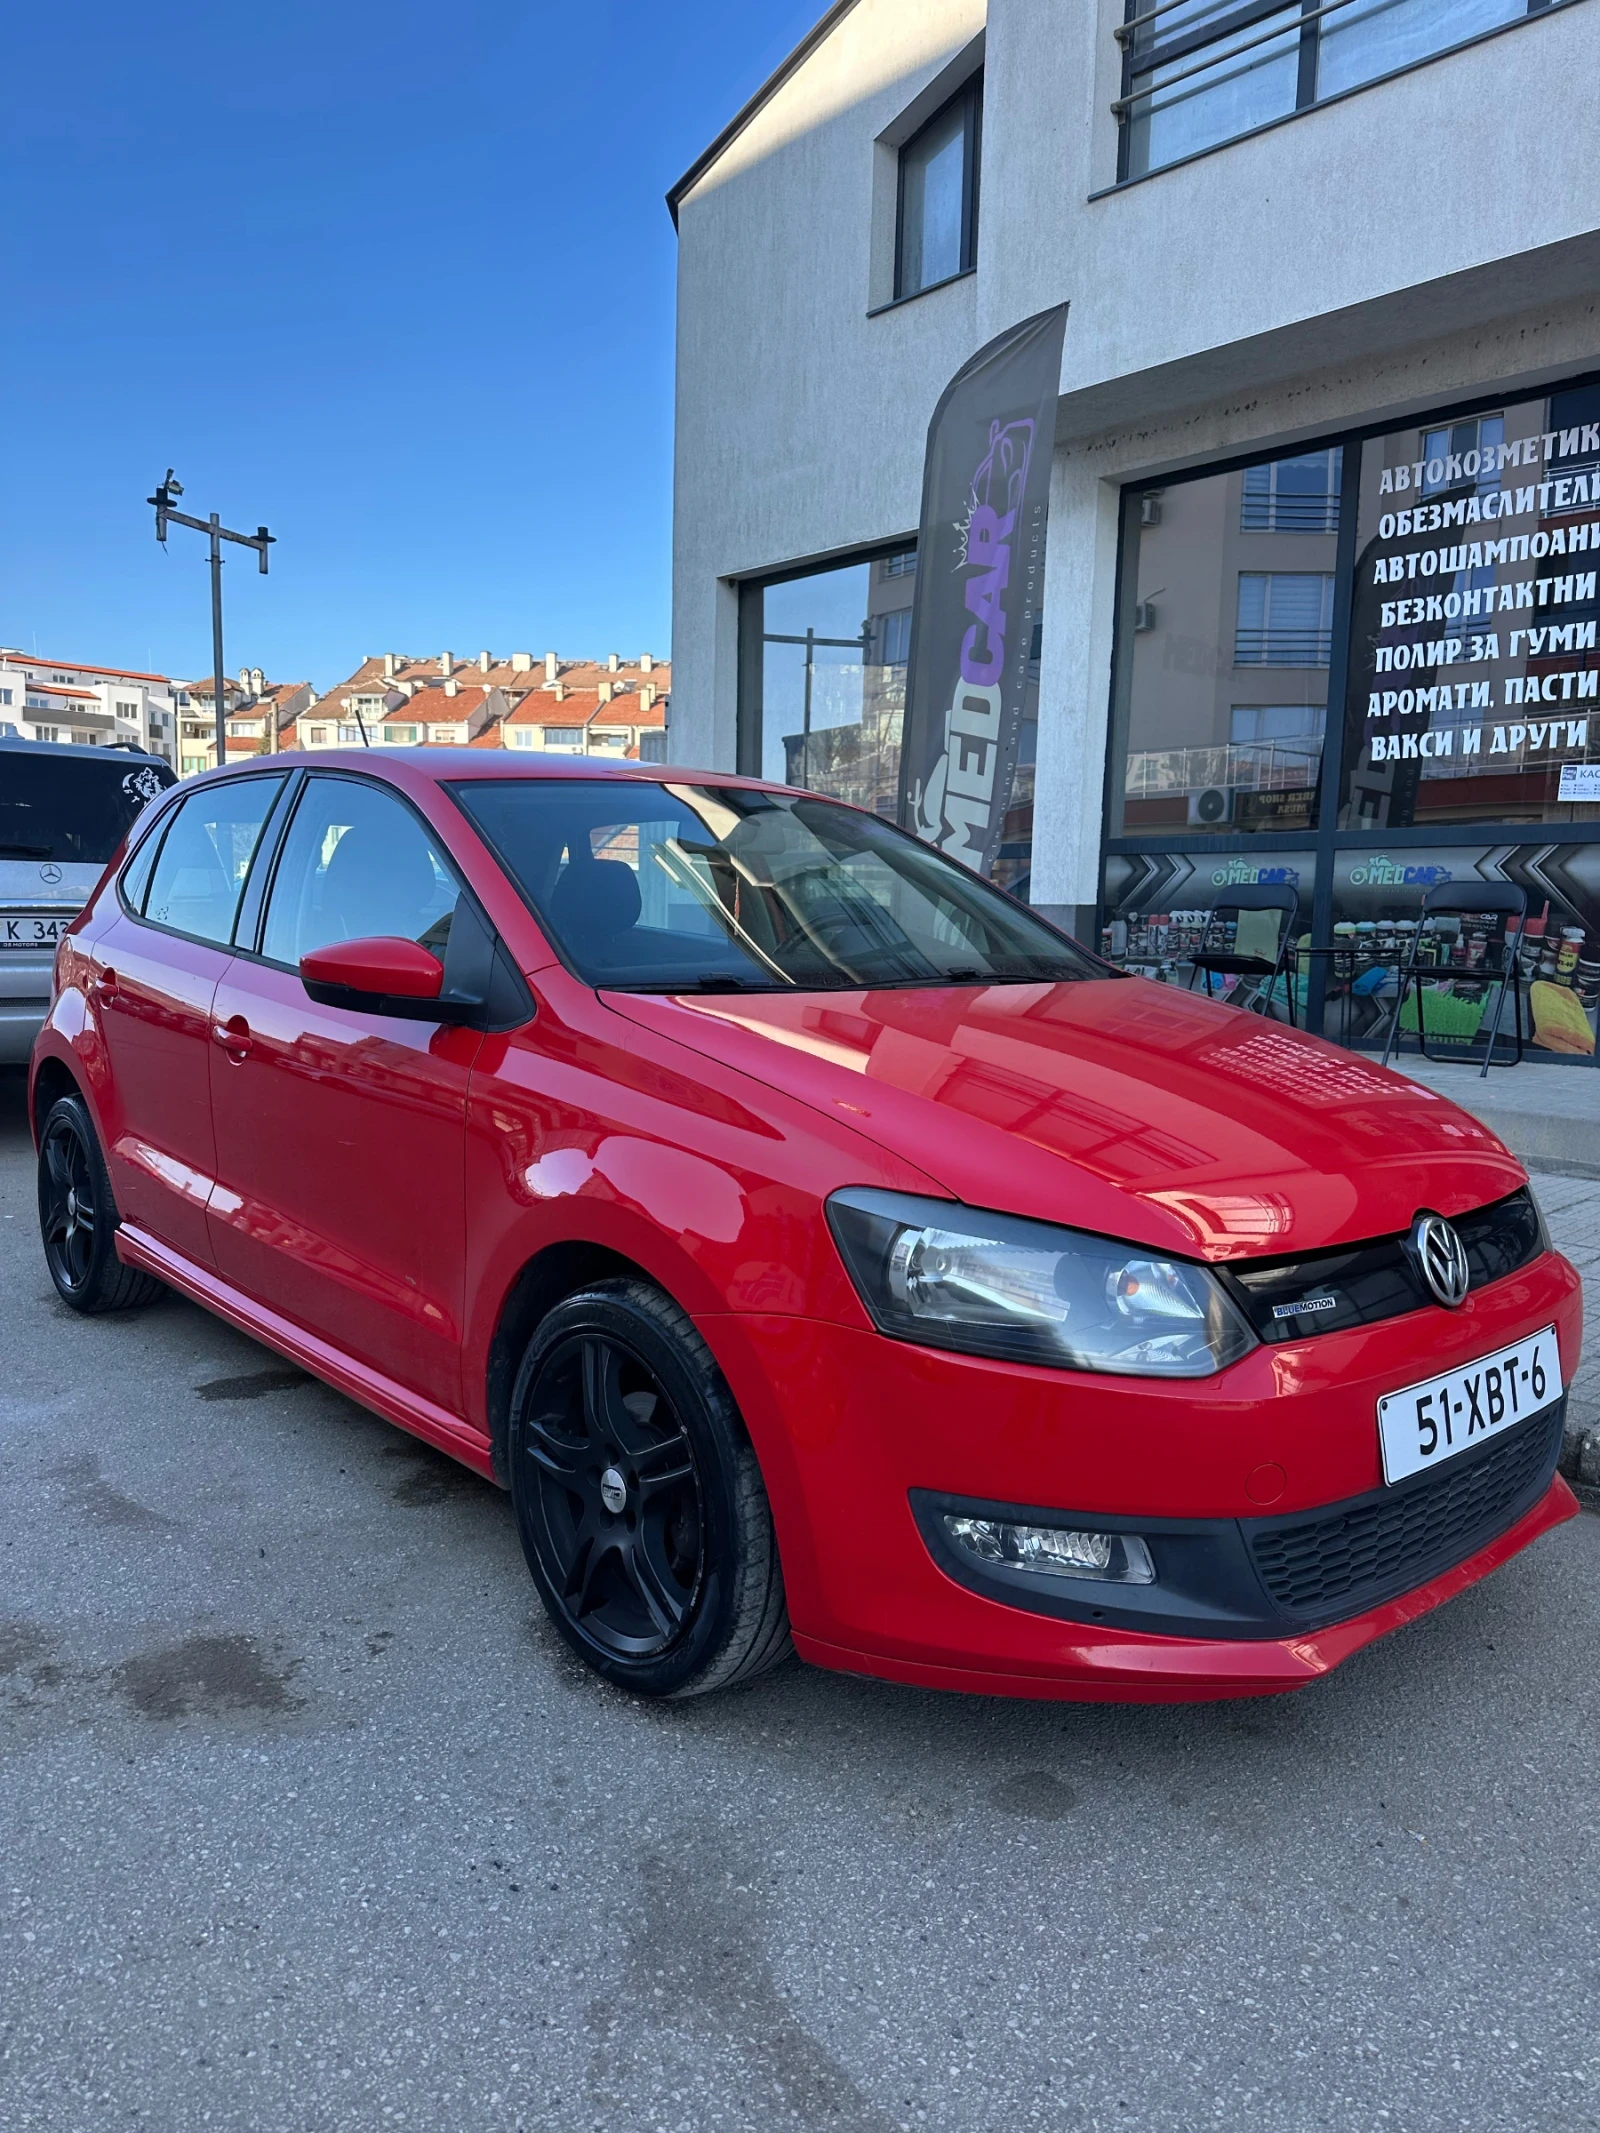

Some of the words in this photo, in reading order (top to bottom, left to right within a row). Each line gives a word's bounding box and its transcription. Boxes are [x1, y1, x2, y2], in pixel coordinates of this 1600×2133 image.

[1379, 422, 1600, 495] АВТОКОЗМЕТИК
[1009, 706, 1020, 745] and
[1016, 636, 1028, 690] care
[1023, 505, 1042, 620] products
[1381, 571, 1597, 628] БЕЗКОНТАКТНИ
[1375, 638, 1462, 673] ПОЛИР
[1470, 633, 1500, 662] ЗА
[1509, 621, 1597, 657] ГУМИ
[941, 503, 1017, 876] MEDCAR
[1367, 681, 1495, 718] АРОМАТИ,
[1504, 670, 1598, 705] ПАСТИ
[1371, 730, 1453, 762] ВАКСИ
[1462, 728, 1482, 756] И
[1490, 719, 1588, 754] ДРУГИ
[1227, 867, 1288, 886] MEDCAR
[1368, 865, 1437, 886] MEDCAR
[1275, 1298, 1334, 1317] BLUEMOTION
[1416, 1346, 1546, 1456] 51-XBT-6
